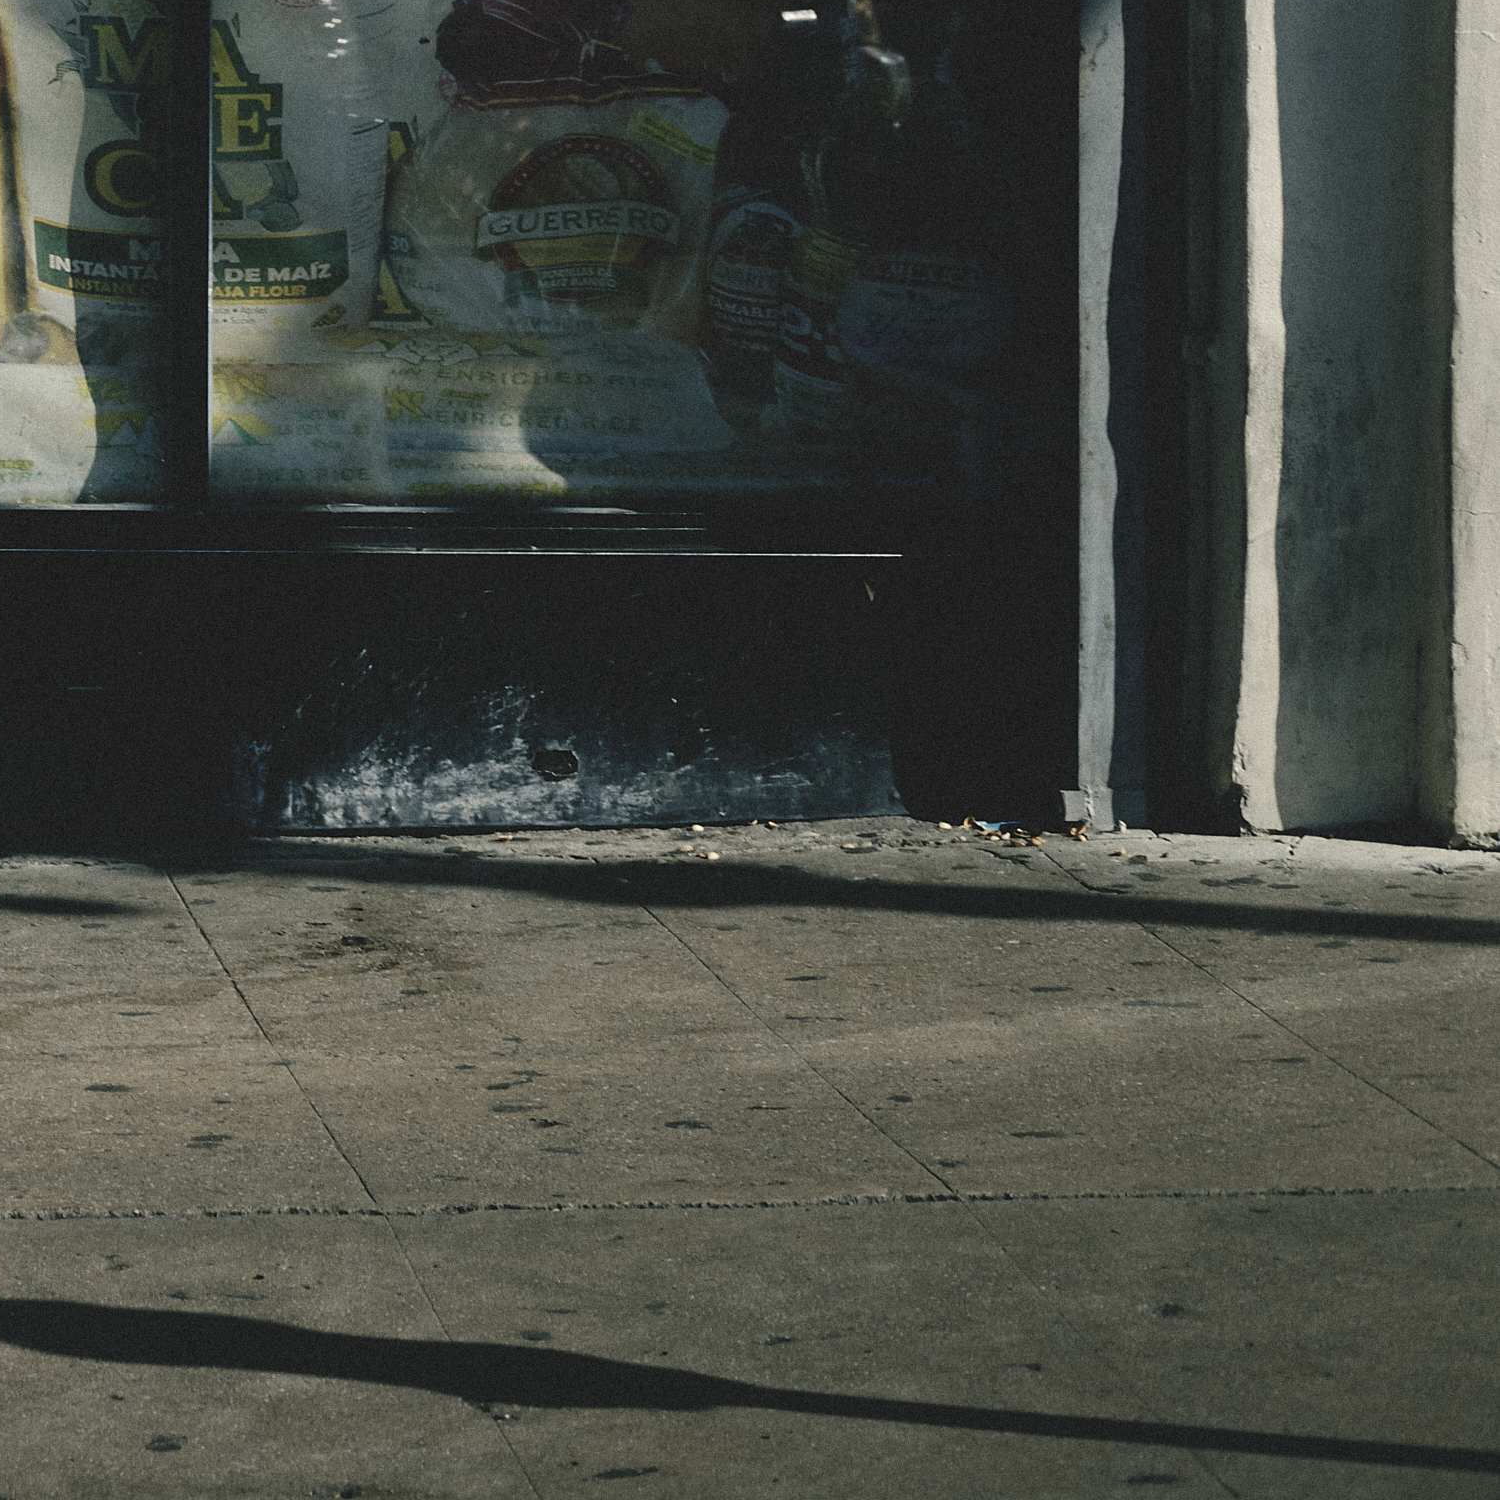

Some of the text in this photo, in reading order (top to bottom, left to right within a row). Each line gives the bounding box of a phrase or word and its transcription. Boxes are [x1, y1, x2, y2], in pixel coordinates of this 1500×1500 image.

[487, 207, 671, 236] GUERRERO
[224, 267, 262, 283] DE
[266, 260, 332, 284] MAÍZ
[213, 284, 245, 298] ASA
[249, 284, 308, 298] FLOUR
